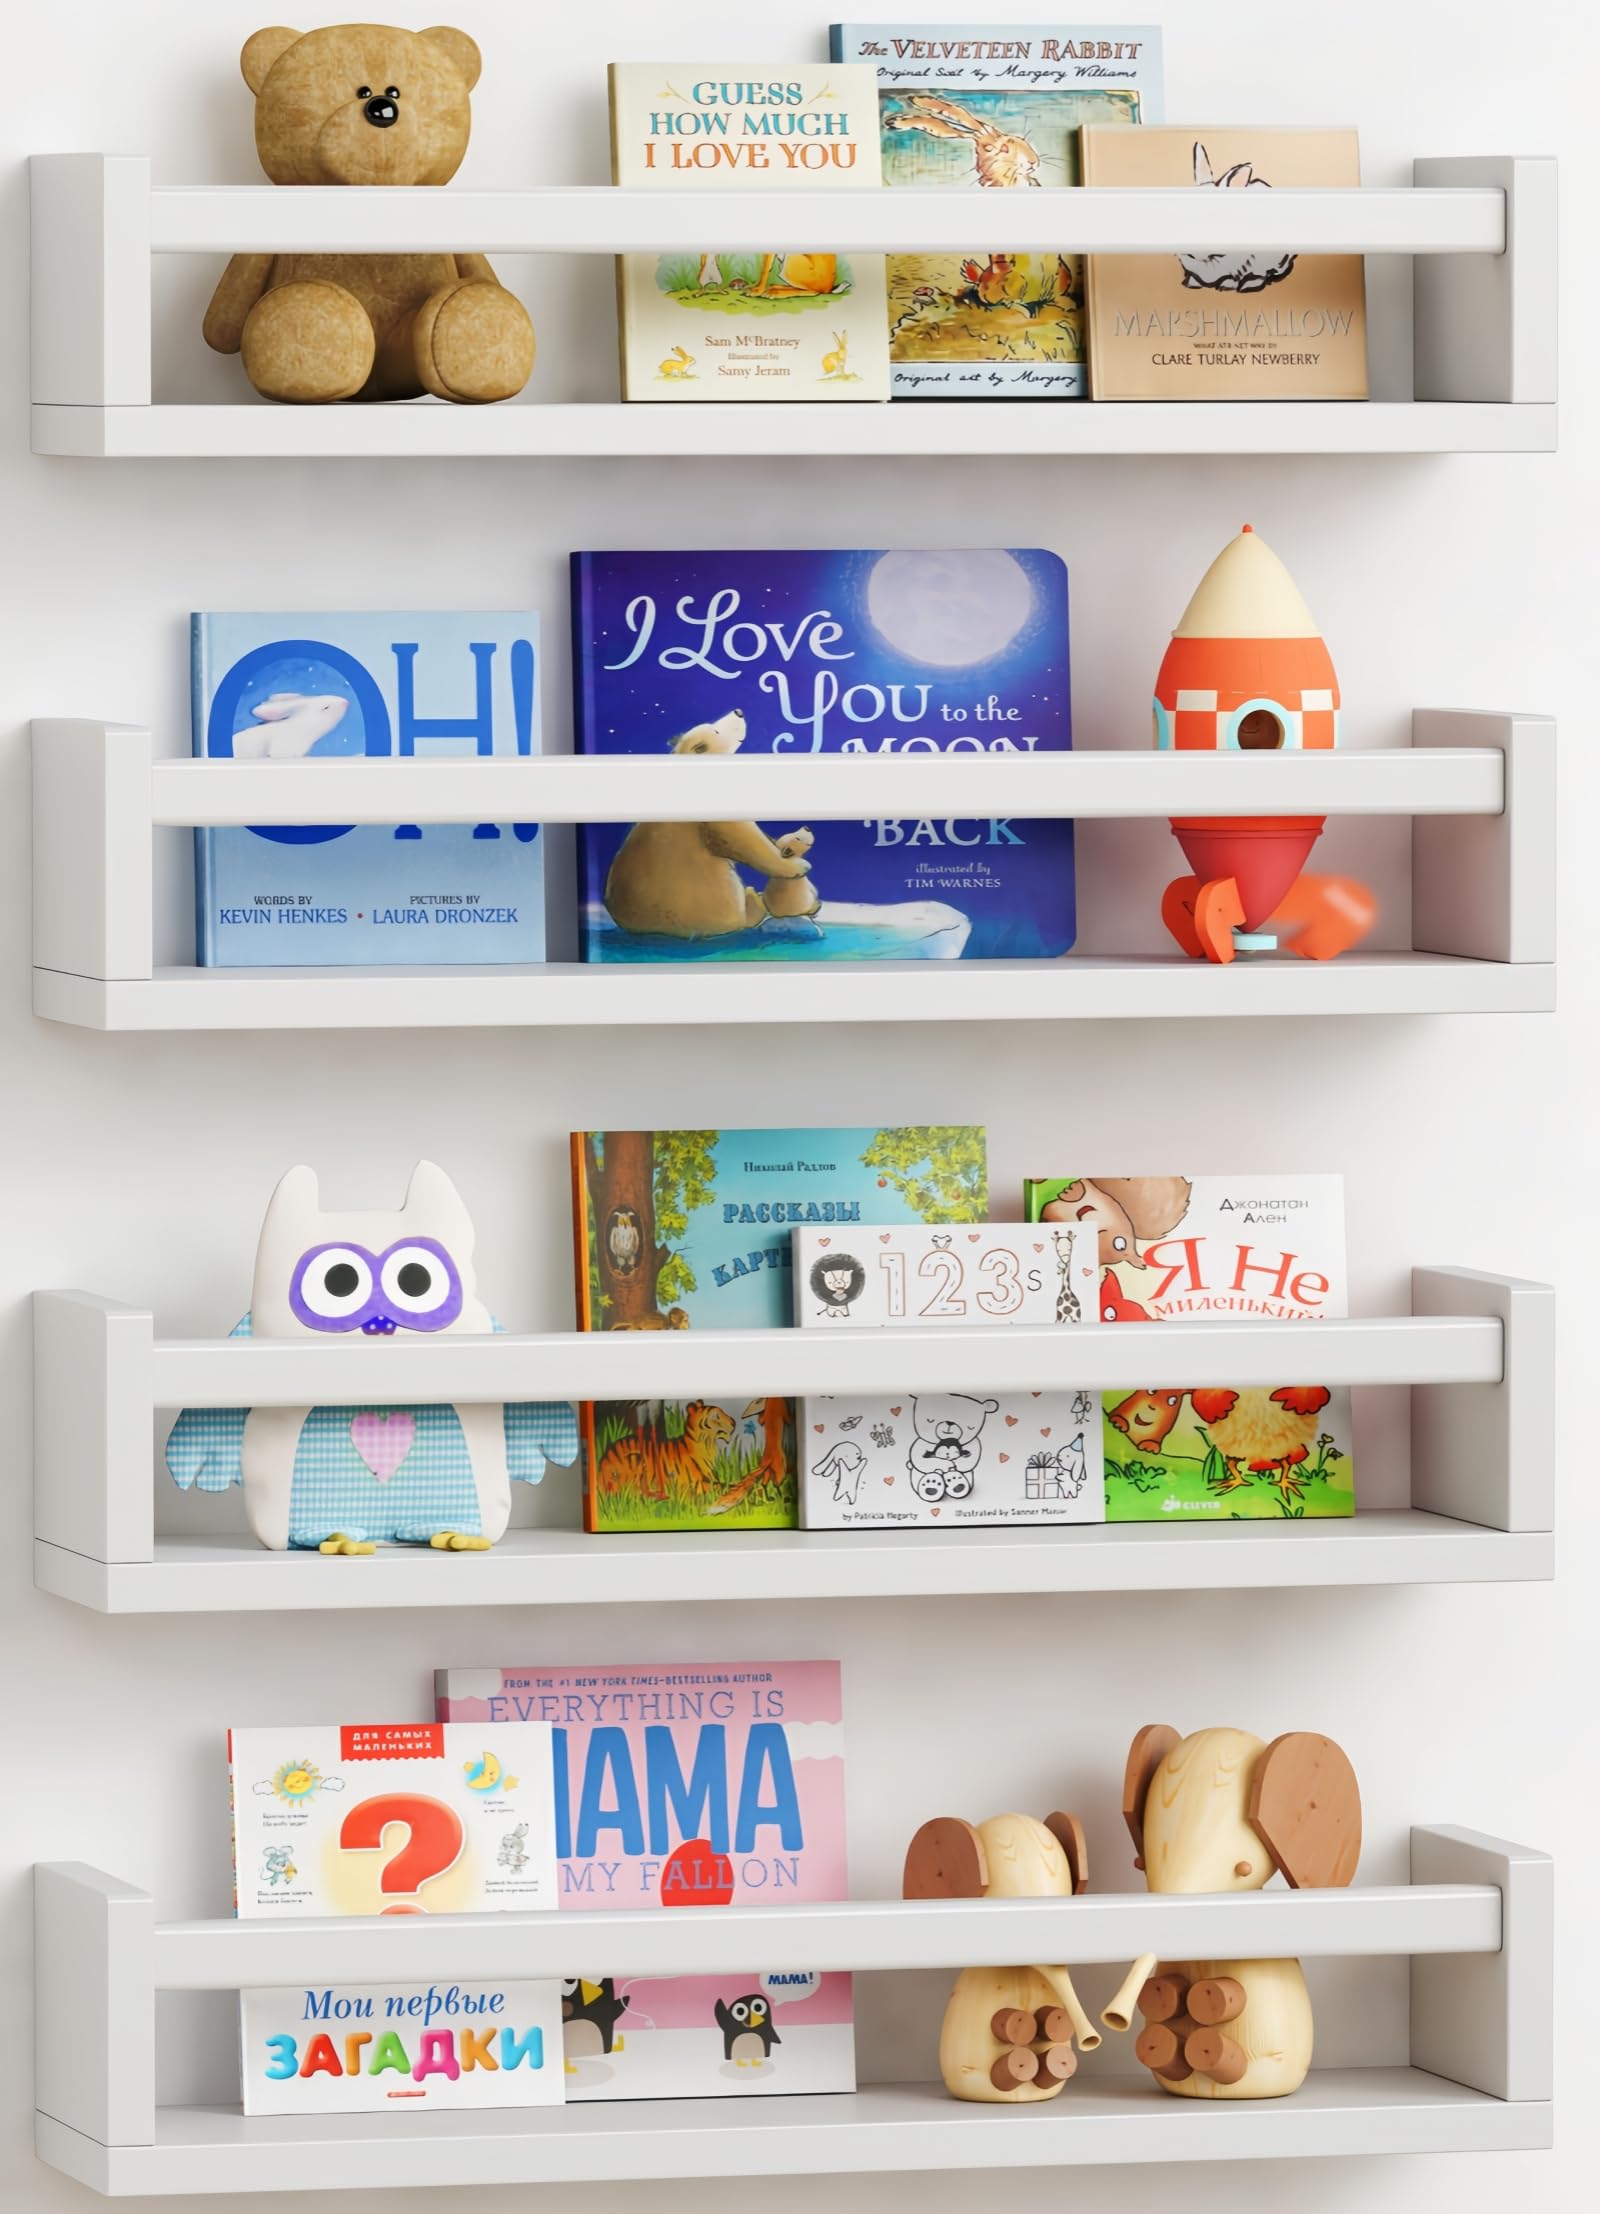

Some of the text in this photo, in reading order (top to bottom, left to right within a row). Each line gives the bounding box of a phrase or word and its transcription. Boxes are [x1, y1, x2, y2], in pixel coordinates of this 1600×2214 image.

[859, 38, 1143, 61] The VELVETEEN RABBIT
[995, 65, 1067, 83] Margery
[1074, 65, 1138, 78] Williams
[692, 82, 803, 105] GUESS
[650, 112, 849, 136] HOW MUCH
[644, 142, 858, 169] I LOVE YOU
[1114, 308, 1356, 338] MARSHMALLOW
[705, 335, 732, 347] Sam
[1152, 353, 1320, 366] CLARE TURLAY NEWBERRY
[755, 365, 791, 376] Jeram
[894, 373, 950, 388] Original
[988, 372, 1004, 387] by
[1011, 370, 1078, 388] Margery
[604, 587, 855, 680] I Love
[940, 703, 968, 722] to
[974, 695, 1023, 721] the
[207, 639, 540, 845] OH!
[863, 817, 1027, 847] BACK
[915, 862, 974, 874] illustrated
[905, 877, 1001, 888] TIM WARNES
[254, 896, 312, 905] WORDS BY
[410, 896, 480, 905] PICTURES BY
[220, 909, 348, 924] KEVIN HENKES
[373, 908, 518, 924] LAURA DRONZEK
[722, 1201, 861, 1223] РАССКАЗЫ
[1219, 1198, 1309, 1211] Джонатан
[1243, 1212, 1287, 1224] Ален
[1142, 1237, 1330, 1306] Я Не
[503, 1679, 530, 1688] FROM
[535, 1679, 553, 1688] THE
[575, 1678, 598, 1687] NEW
[602, 1677, 627, 1686] YORK
[733, 1673, 773, 1683] AUTHOR
[488, 1690, 786, 1722] EVERYTHING IS
[386, 1731, 431, 1739] САМЫХ
[353, 1742, 432, 1751] МАЛЕНЬКИХ
[552, 1722, 804, 1859] AMA
[640, 1857, 801, 1891] FALLON
[769, 1972, 813, 1985] MAMA!
[302, 1985, 506, 2027] Мои первые
[264, 2026, 545, 2083] ЗАГАДКИ
